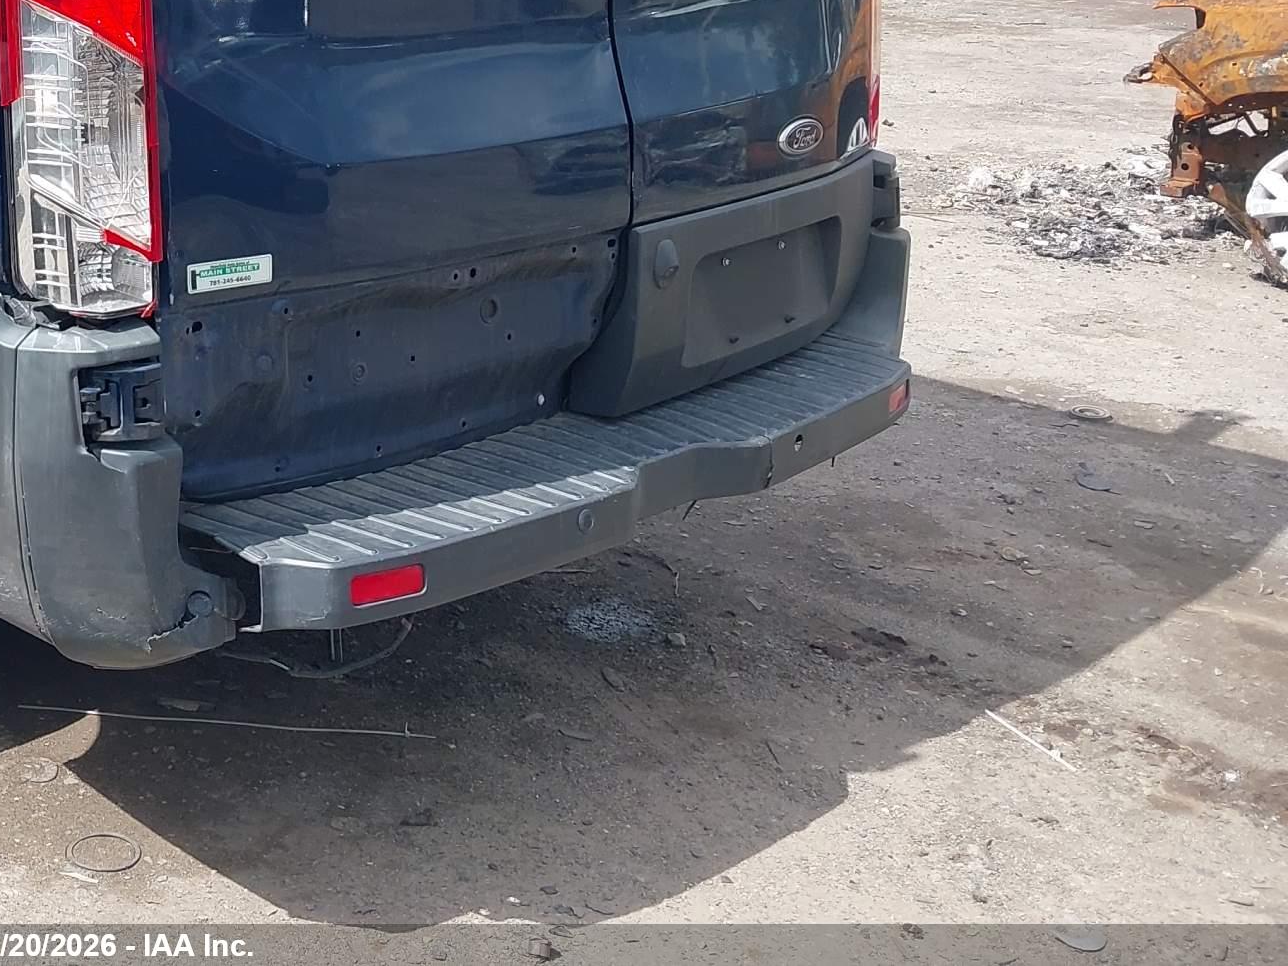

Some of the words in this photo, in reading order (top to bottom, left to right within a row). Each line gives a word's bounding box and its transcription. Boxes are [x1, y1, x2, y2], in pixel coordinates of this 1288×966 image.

[793, 127, 817, 149] Ford
[200, 268, 223, 277] MAIN
[225, 264, 259, 274] STREET
[209, 275, 252, 286] 781-245-6640
